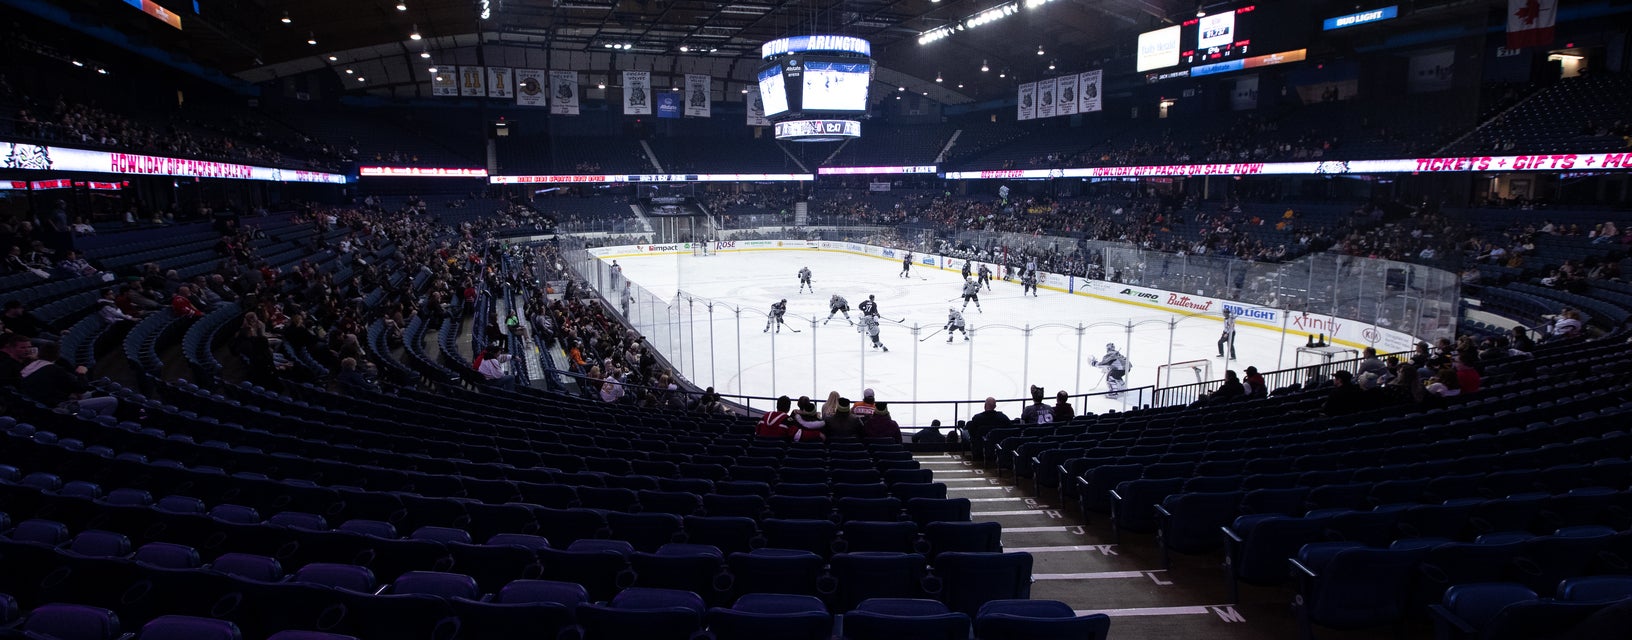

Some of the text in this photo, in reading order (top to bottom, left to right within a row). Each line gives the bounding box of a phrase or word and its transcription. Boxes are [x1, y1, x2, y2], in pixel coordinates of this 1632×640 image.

[1336, 11, 1383, 26] BUD LIGHT
[806, 35, 866, 54] ARLINGTON
[464, 72, 481, 88] 11
[110, 152, 164, 174] HOWLIDAY
[167, 158, 186, 175] GIFT
[188, 160, 212, 177] PACKS
[1093, 162, 1264, 176] HOWLIDAY GIFT PACKS ON SALE NOW!
[1416, 157, 1492, 171] TICKETS
[1512, 154, 1578, 170] GIFTS
[716, 241, 736, 250] ROSE
[1167, 293, 1213, 312] Butternut
[1223, 304, 1276, 321] BUD LIGHT
[1293, 313, 1342, 337] xfinity
[1024, 498, 1038, 506] G
[1046, 510, 1063, 518] H
[1072, 526, 1086, 535] J
[1098, 545, 1118, 556] K
[1147, 570, 1174, 586] L
[1212, 606, 1246, 623] M
